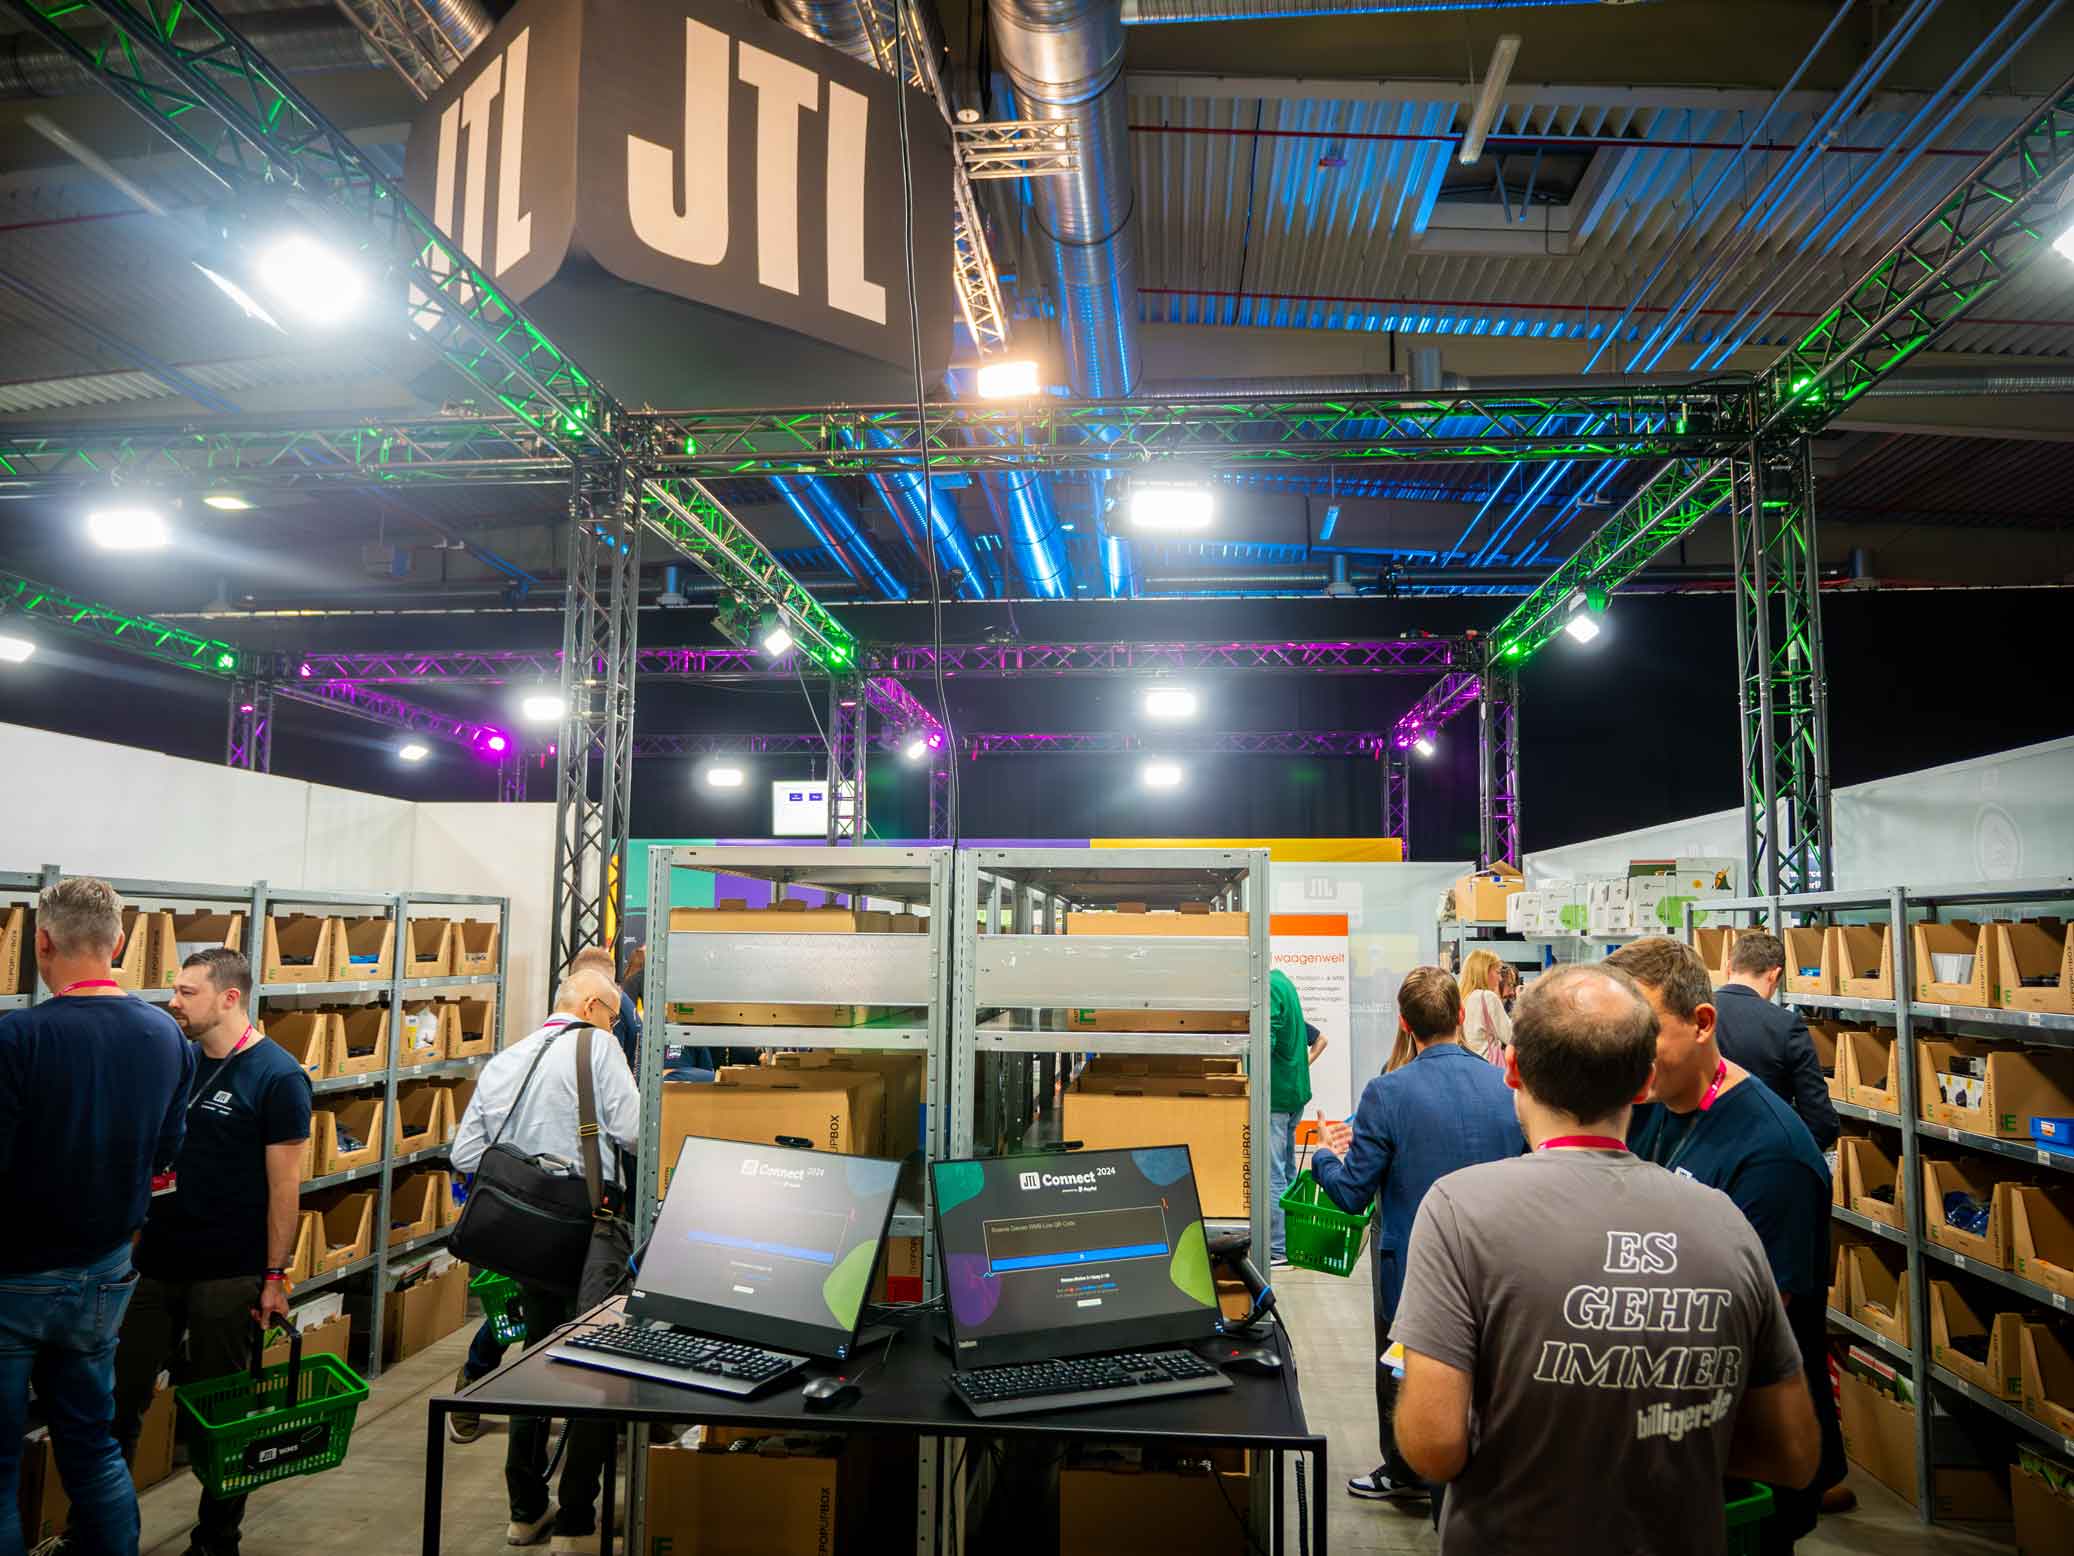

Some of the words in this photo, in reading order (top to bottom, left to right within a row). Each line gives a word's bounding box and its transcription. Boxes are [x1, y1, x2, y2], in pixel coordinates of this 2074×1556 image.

[628, 17, 887, 325] JTL
[1042, 1171, 1097, 1186] Connect
[1096, 1166, 1117, 1177] 2024
[1603, 1231, 1678, 1274] ES
[1563, 1284, 1732, 1332] GEHT
[1533, 1340, 1743, 1390] IMMER
